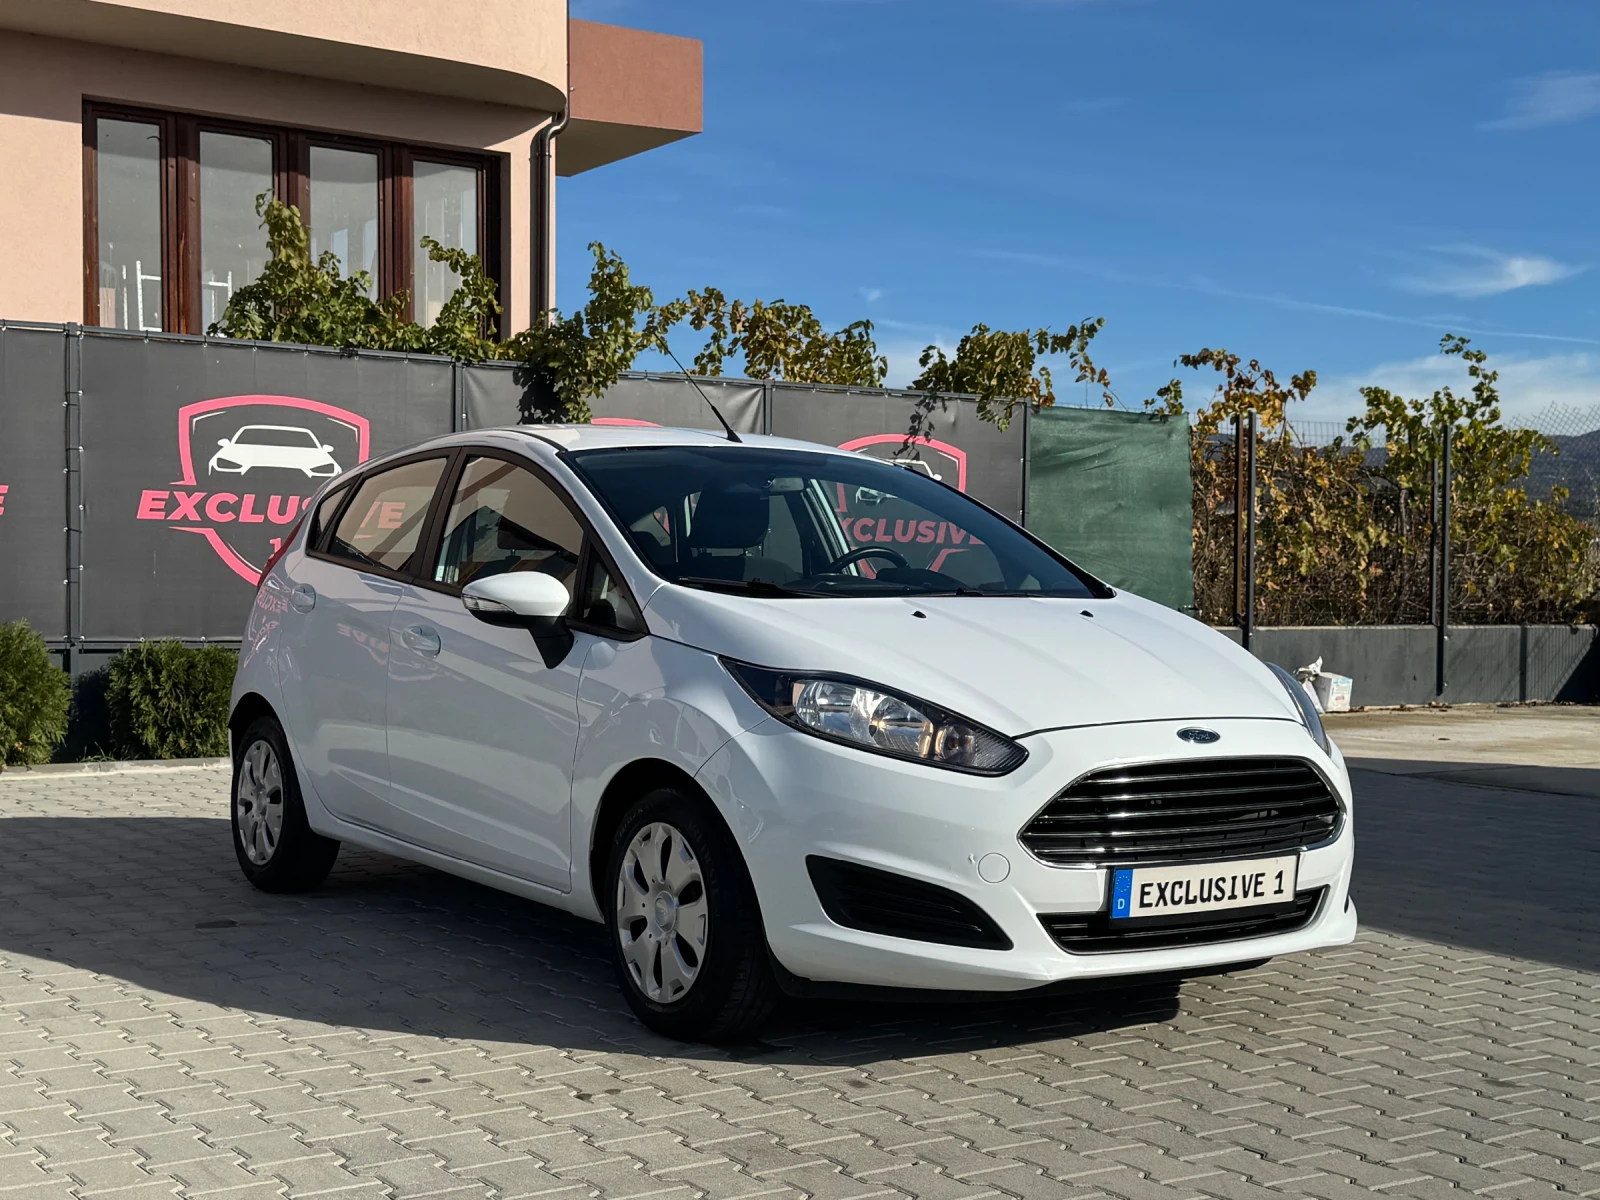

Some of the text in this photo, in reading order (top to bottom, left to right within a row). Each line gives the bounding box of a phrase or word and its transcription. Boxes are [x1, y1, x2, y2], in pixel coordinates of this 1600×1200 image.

[1139, 870, 1284, 908] EXCLUSIVE 1
[1117, 898, 1125, 910] D
